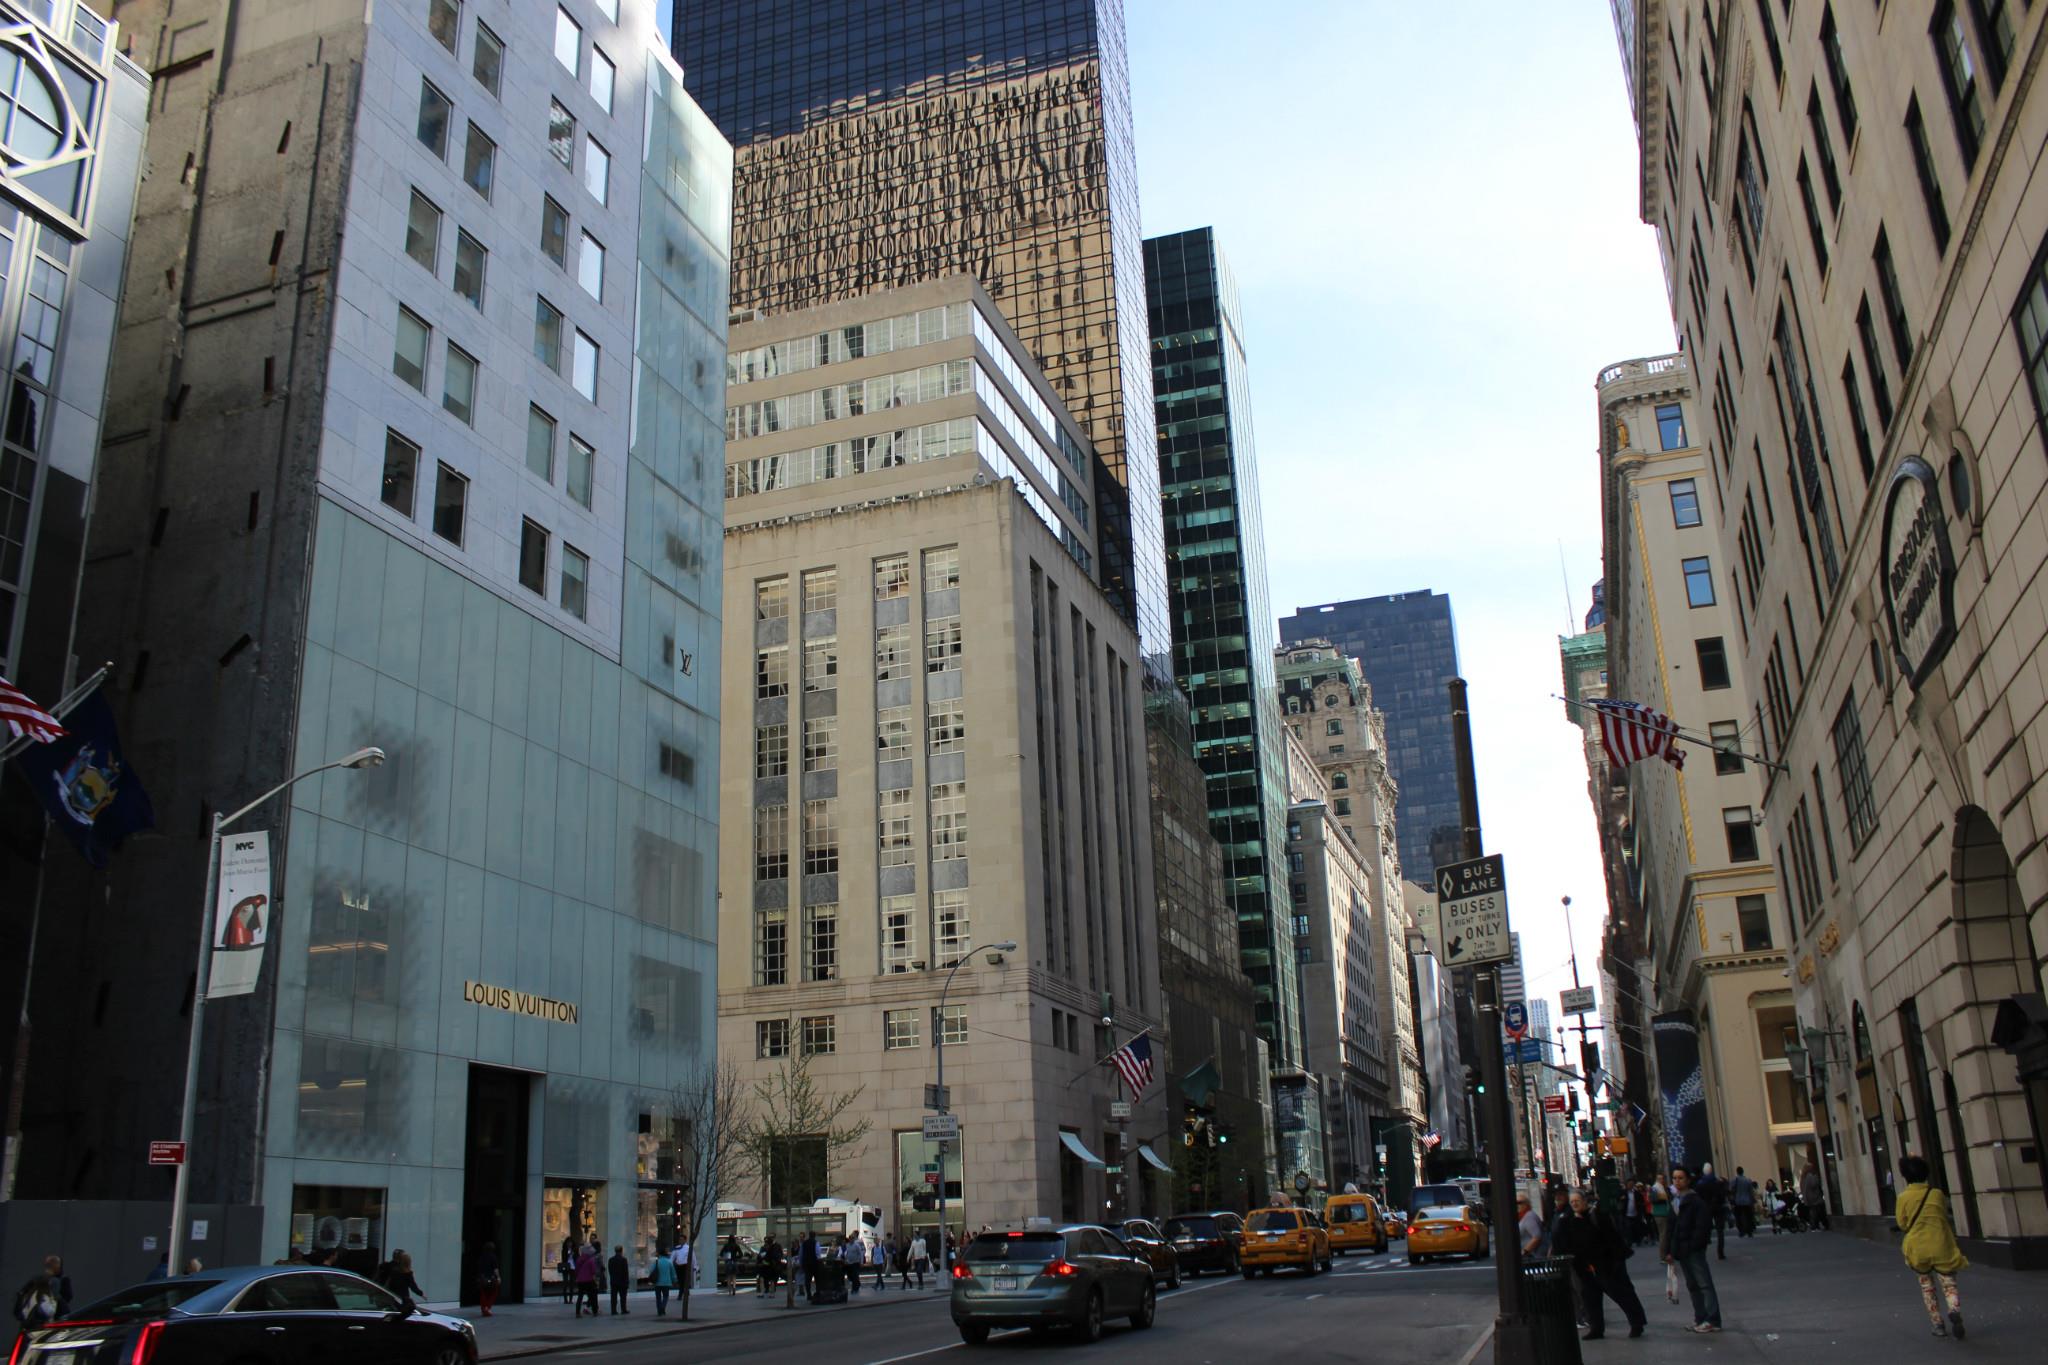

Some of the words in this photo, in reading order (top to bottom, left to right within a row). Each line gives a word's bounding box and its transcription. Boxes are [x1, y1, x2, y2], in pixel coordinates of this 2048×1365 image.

[235, 841, 255, 851] NYC
[1463, 863, 1493, 879] BUS
[1461, 877, 1497, 894] LANE
[1450, 897, 1496, 917] BUSES
[1455, 917, 1474, 927] RIGHT
[1466, 921, 1501, 940] ONLY
[464, 980, 511, 1010] LOUIS
[516, 992, 578, 1025] VUITTON
